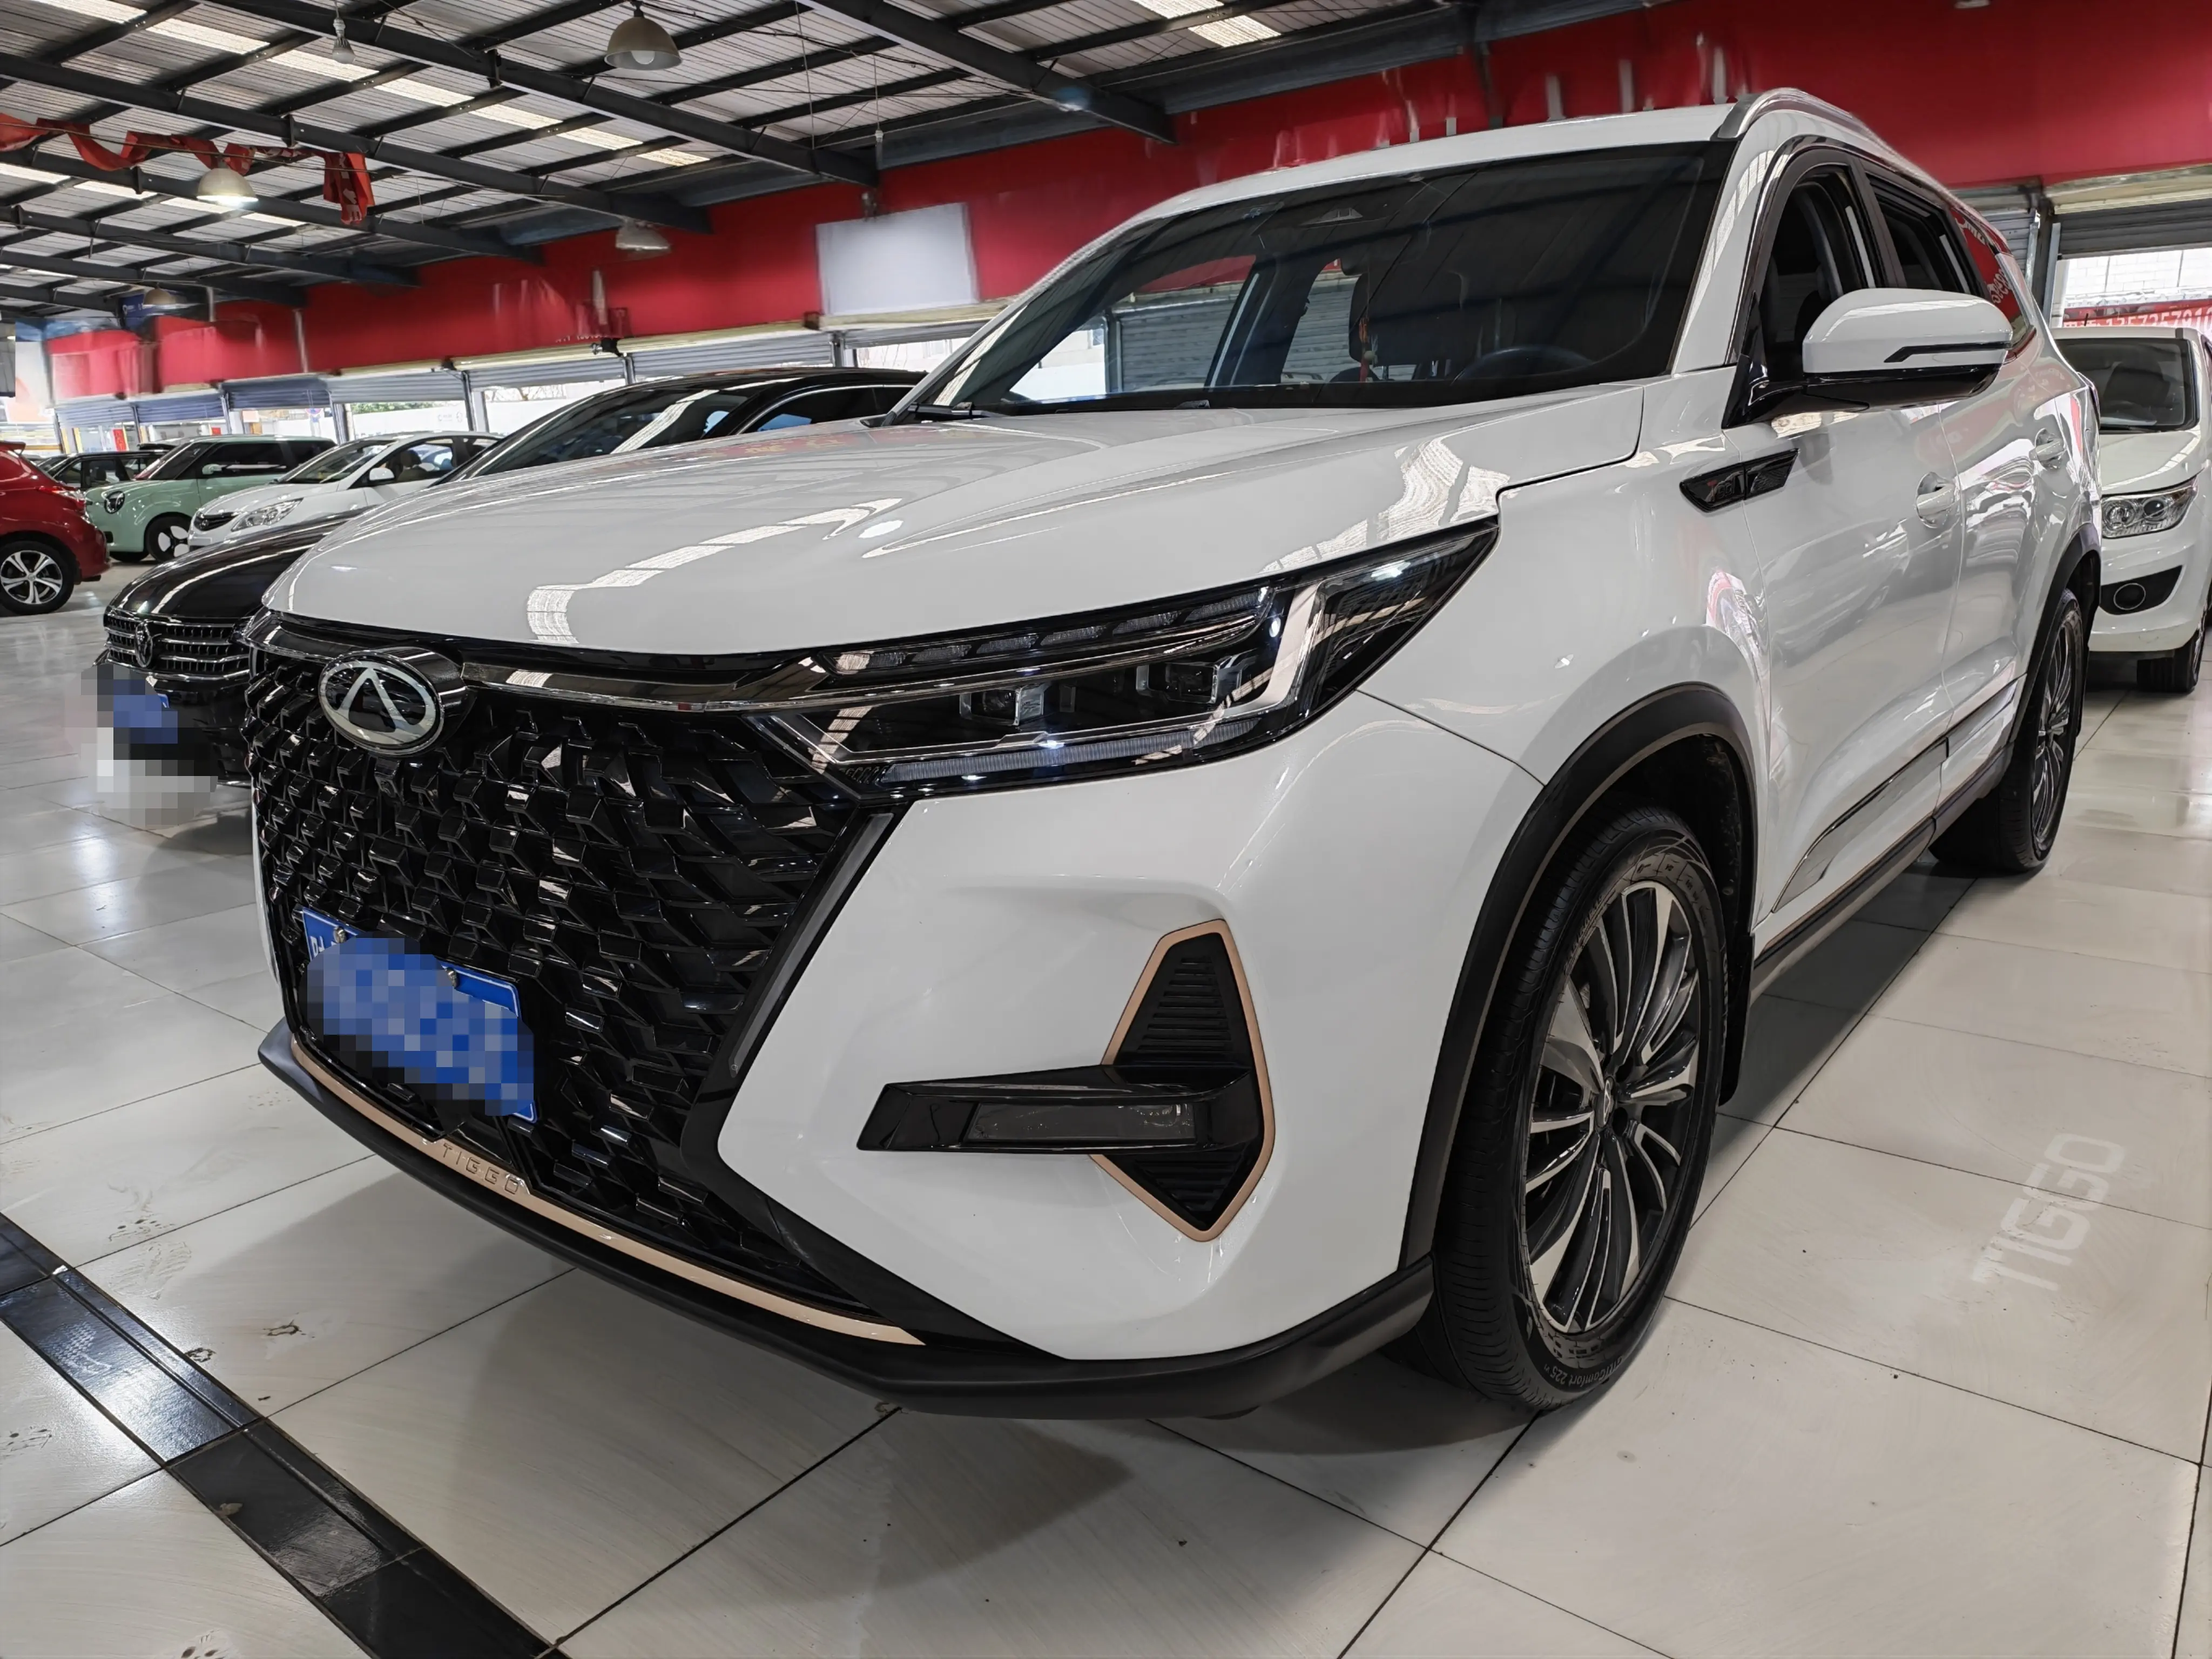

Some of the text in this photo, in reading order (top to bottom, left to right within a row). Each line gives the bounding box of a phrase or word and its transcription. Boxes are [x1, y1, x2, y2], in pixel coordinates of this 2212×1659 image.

[442, 1142, 520, 1195] TIGGO
[1971, 1132, 2126, 1291] TIGGO
[1549, 1366, 1568, 1385] 225
